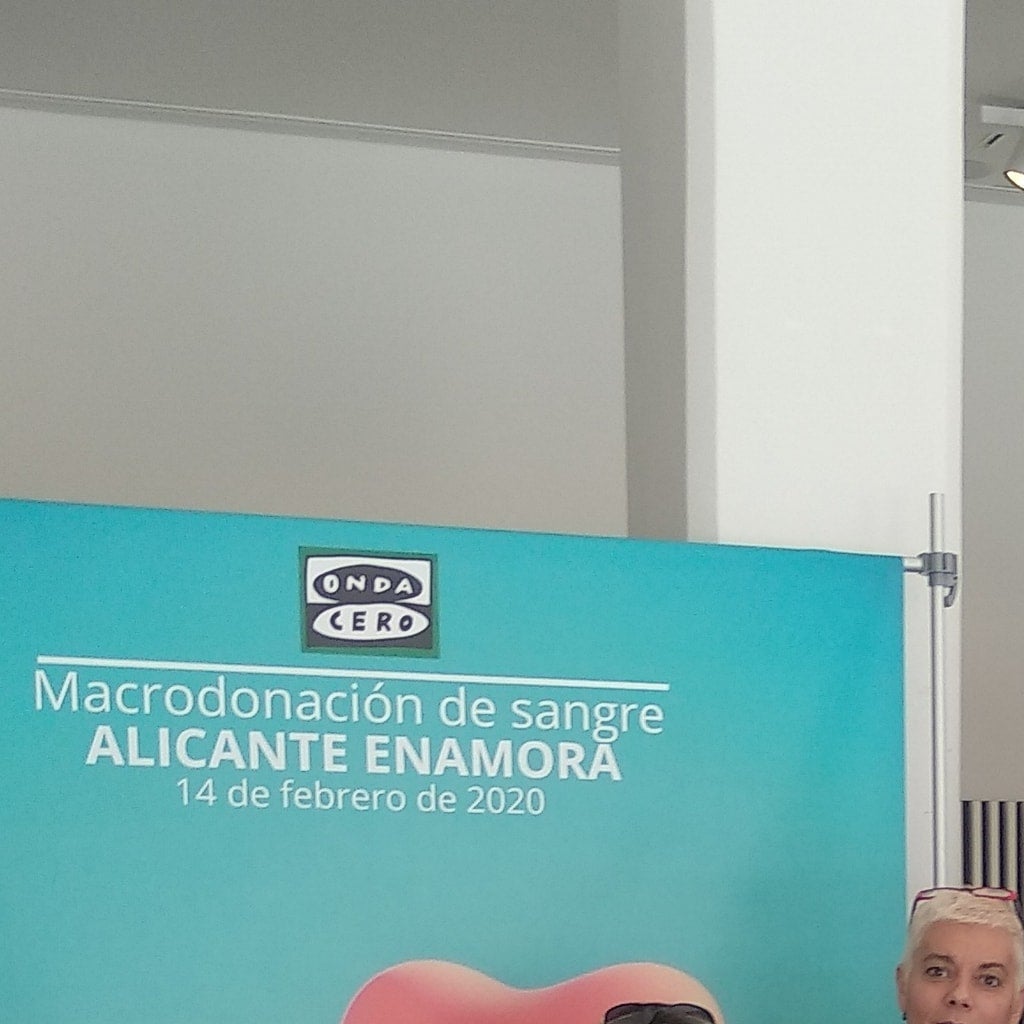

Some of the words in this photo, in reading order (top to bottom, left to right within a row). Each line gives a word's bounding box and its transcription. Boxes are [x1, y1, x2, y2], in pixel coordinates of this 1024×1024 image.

[322, 573, 414, 595] ONDA
[329, 610, 414, 632] CERO
[33, 669, 423, 727] Macrodonación
[439, 687, 498, 729] de
[511, 699, 665, 742] sangre
[86, 725, 348, 774] ALICANTE
[366, 734, 623, 781] ENAMORA
[177, 777, 218, 806] 14
[228, 778, 270, 808] de
[280, 779, 407, 812] febrero
[415, 783, 456, 814] de
[467, 785, 546, 816] 2020
